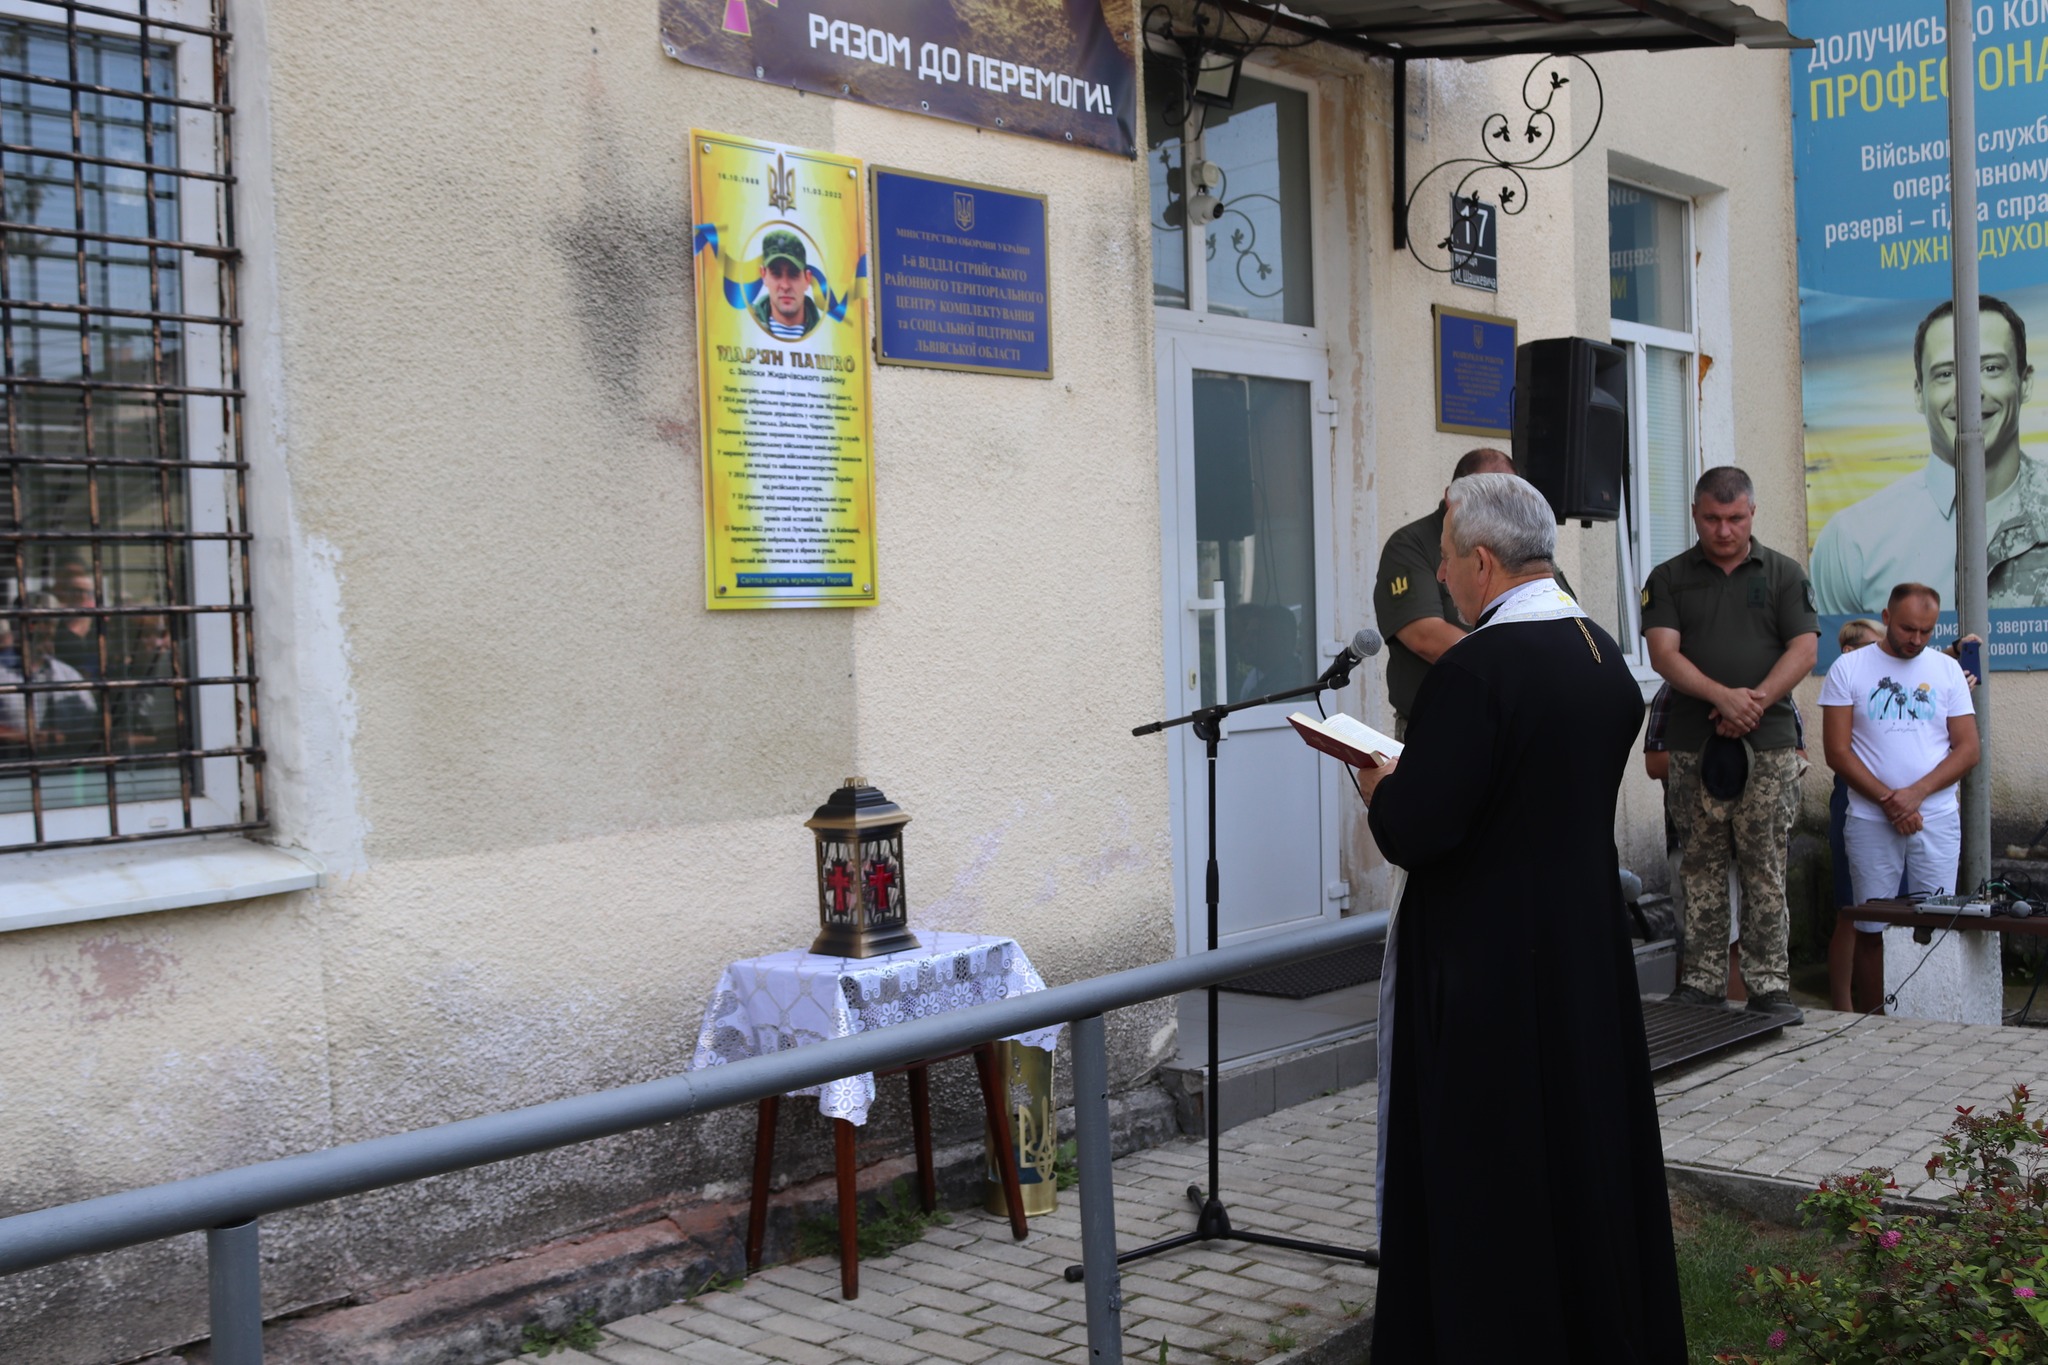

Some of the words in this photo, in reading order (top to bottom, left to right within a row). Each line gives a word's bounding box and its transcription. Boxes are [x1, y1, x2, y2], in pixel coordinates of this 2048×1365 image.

[1808, 16, 1947, 73] ДОЛУЧИСЬ
[808, 12, 911, 71] РАЗОМ
[918, 41, 961, 84] ДО
[967, 51, 1113, 115] ПЕРЕМОГИ!
[1810, 37, 2048, 121] ПРОФЕОН
[1861, 139, 1951, 171] Військо
[896, 227, 957, 245] МІНІСТЕРСТВО
[958, 236, 996, 250] ОБОРОНИ
[1460, 204, 1489, 248] 17
[1825, 209, 1903, 248] резерві
[1880, 235, 1952, 270] МУЖН
[1978, 222, 2048, 260] ДУХО
[919, 256, 953, 272] ВІДДІЛ
[955, 260, 1027, 282] СТРИЙСЬКОГО
[884, 271, 949, 293] РАЙОННОГО
[951, 280, 1044, 304] ТЕРИТОРІАЛЬНОГО
[896, 295, 937, 313] ЦЕНТРУ
[940, 298, 1035, 323] КОМПЛЕКТУВАННЯ
[910, 317, 975, 337] СОЦІАЛЬНОЇ
[977, 327, 1035, 343] ПІДТРИМКИ
[915, 339, 976, 357] ЛЬВІВСЬКОЇ
[978, 345, 1021, 361] ОБЛАСТІ
[738, 367, 765, 378] Заліски
[821, 374, 846, 386] району
